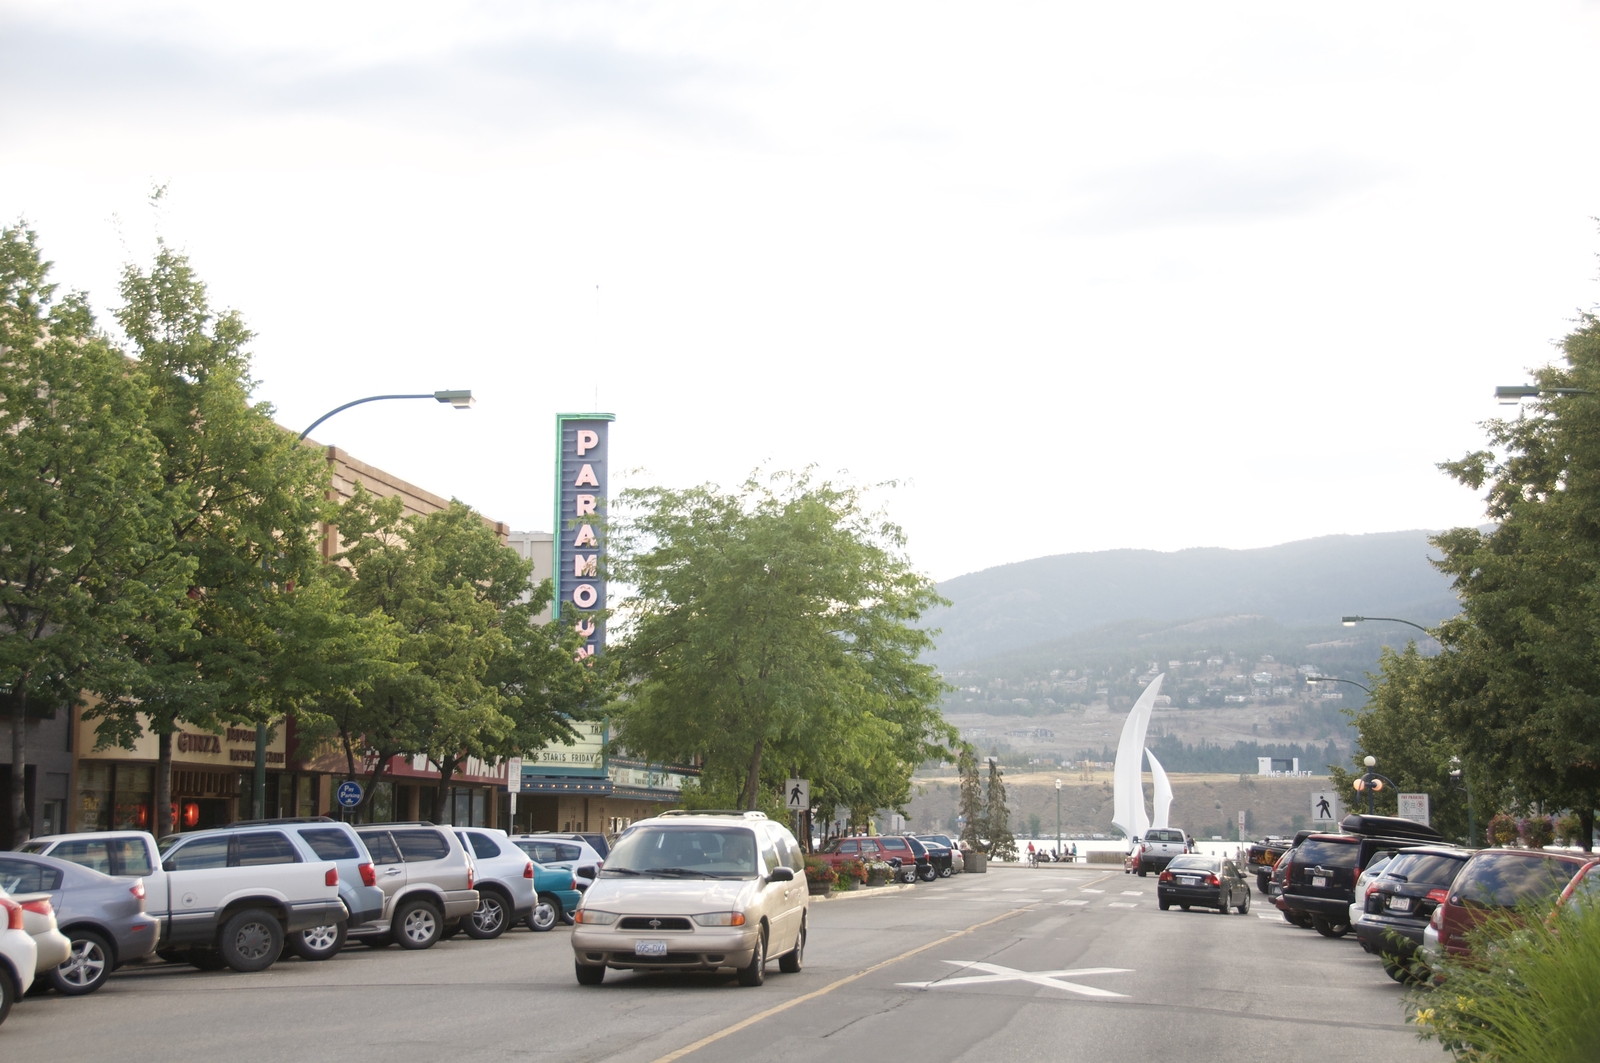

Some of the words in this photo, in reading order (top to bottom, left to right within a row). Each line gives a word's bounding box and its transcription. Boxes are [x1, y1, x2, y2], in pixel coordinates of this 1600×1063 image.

[177, 732, 222, 754] GINZA
[542, 752, 566, 762] STARTS
[571, 753, 595, 763] FRIDAY
[1265, 770, 1281, 778] THE
[1285, 770, 1313, 778] BLUFF
